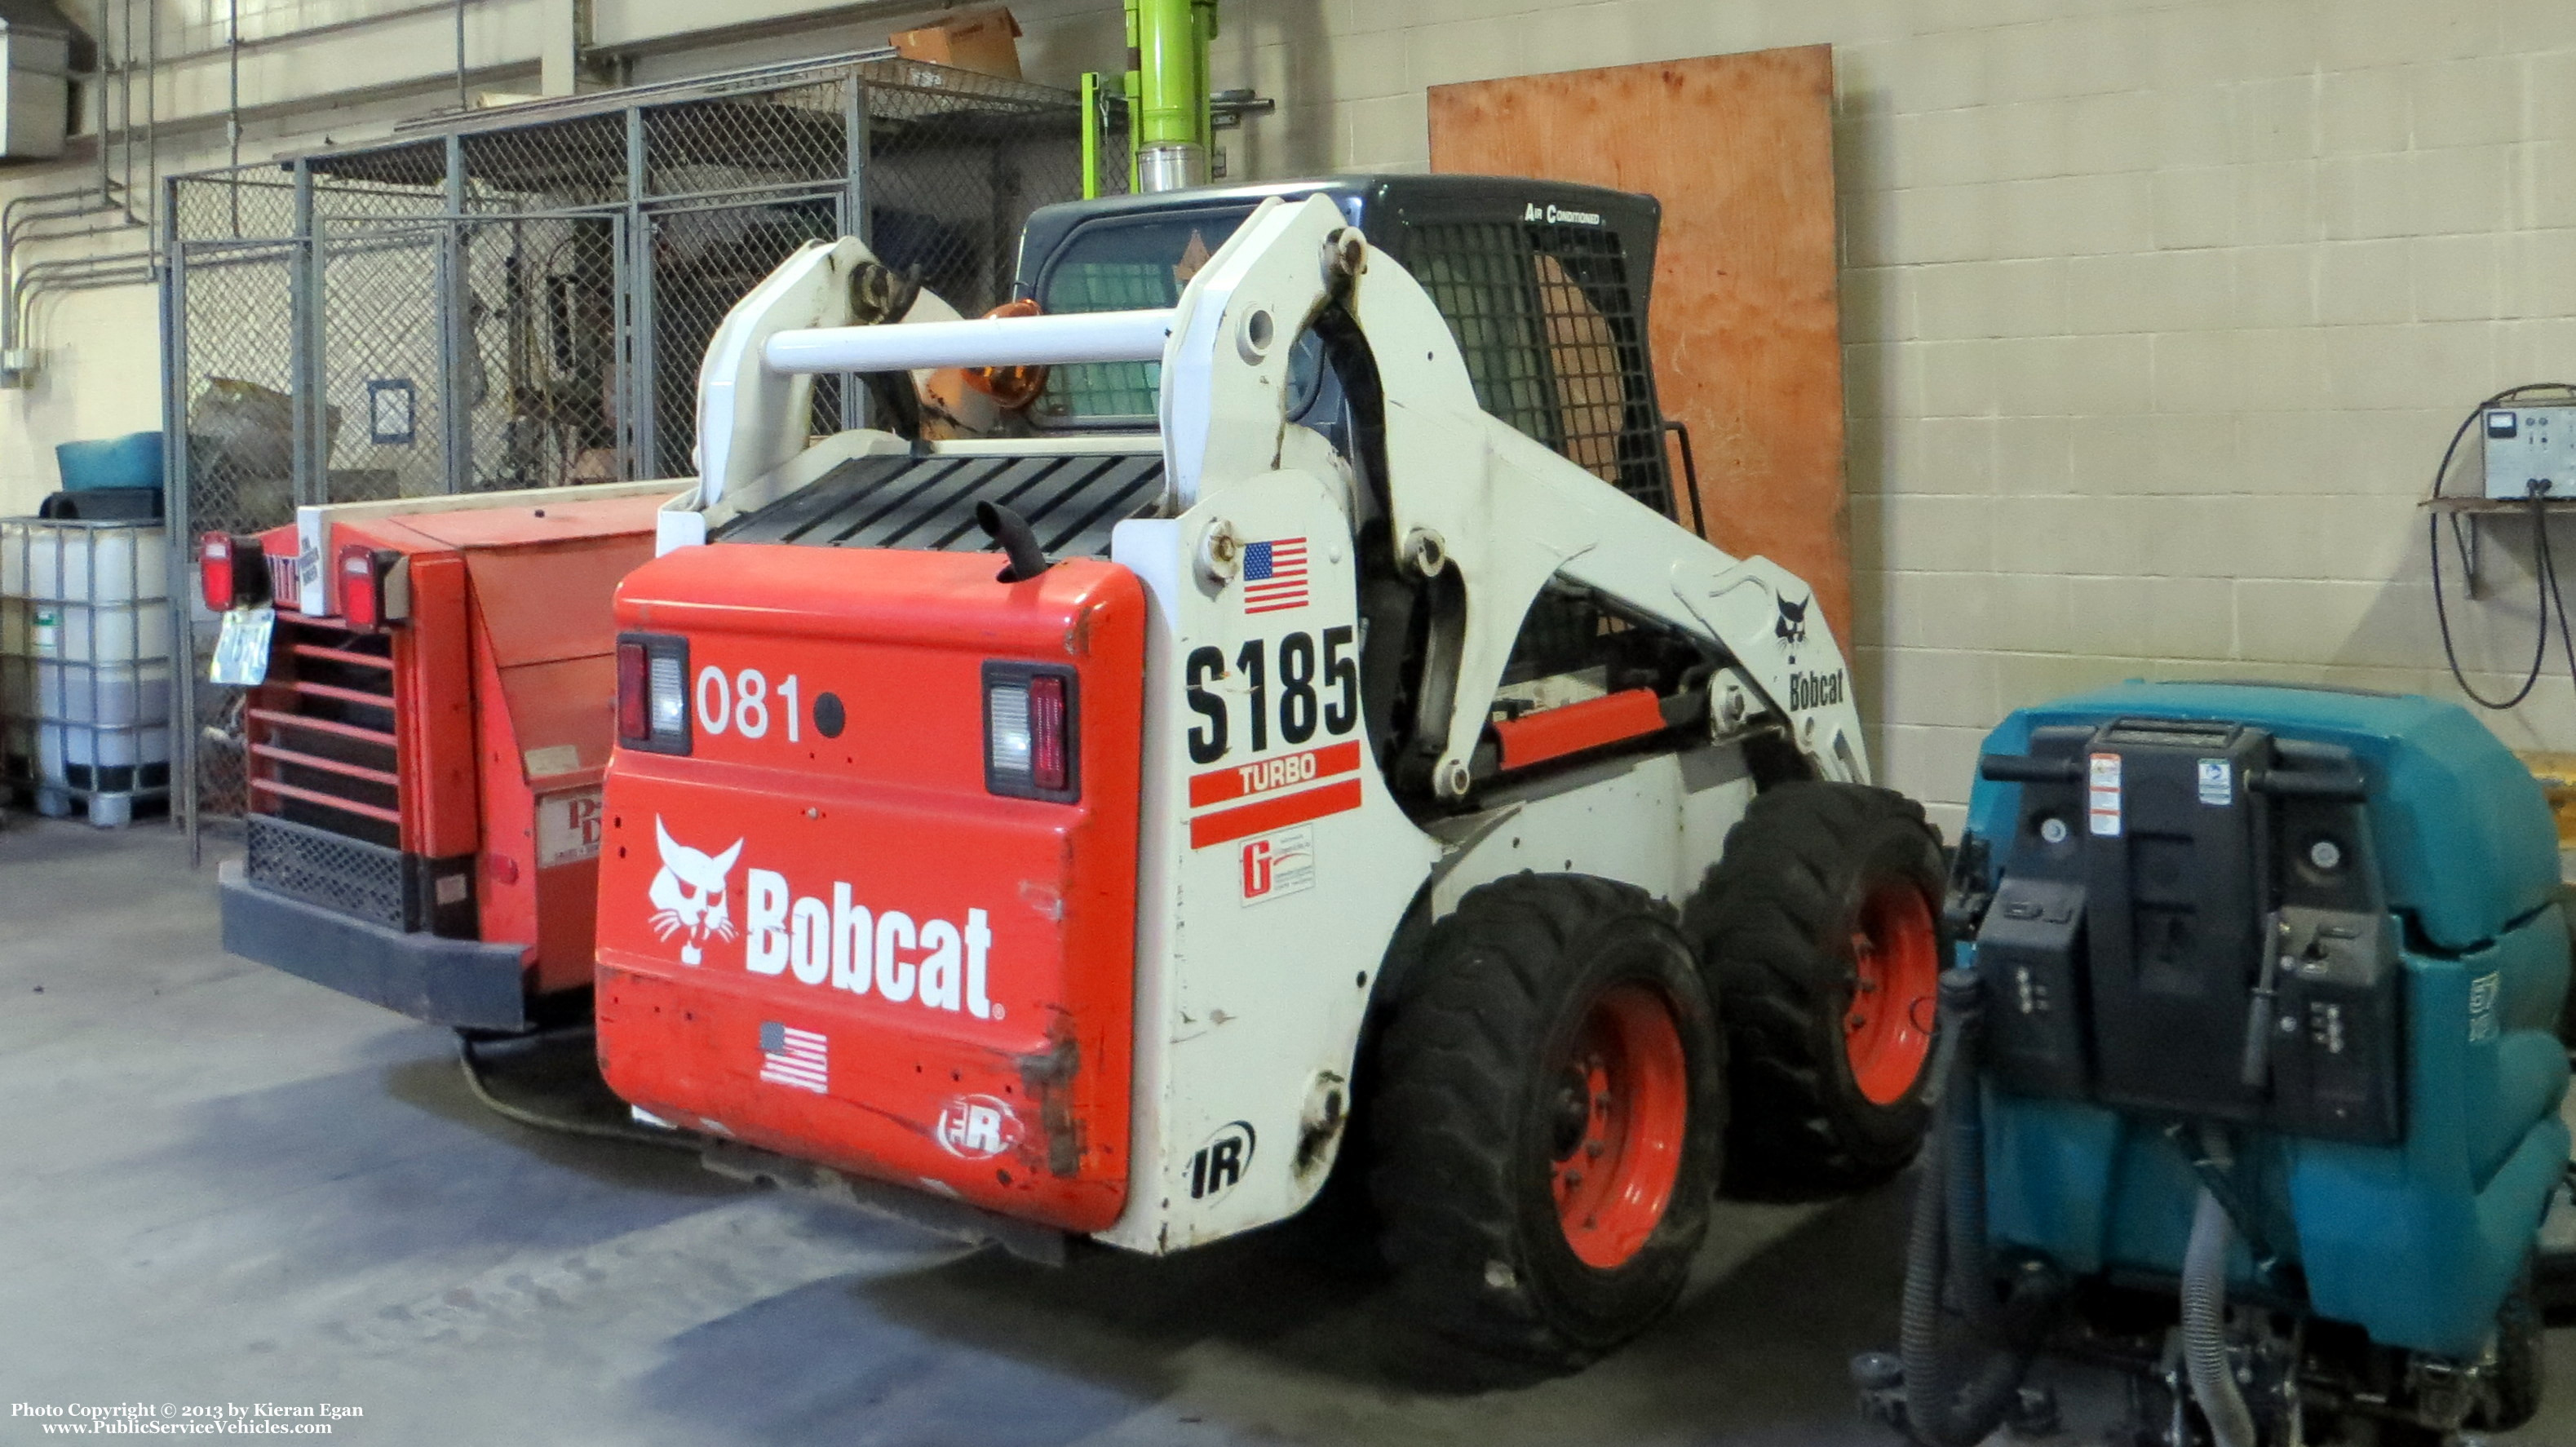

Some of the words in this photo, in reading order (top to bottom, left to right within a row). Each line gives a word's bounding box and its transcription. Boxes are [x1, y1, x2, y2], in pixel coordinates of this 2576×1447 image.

[697, 665, 800, 742] 081
[1186, 625, 1358, 764] S185
[1789, 667, 1843, 712] Bobcat
[1238, 753, 1316, 794] TURBO
[746, 867, 992, 1020] Bobcat
[1191, 1135, 1243, 1199] IR
